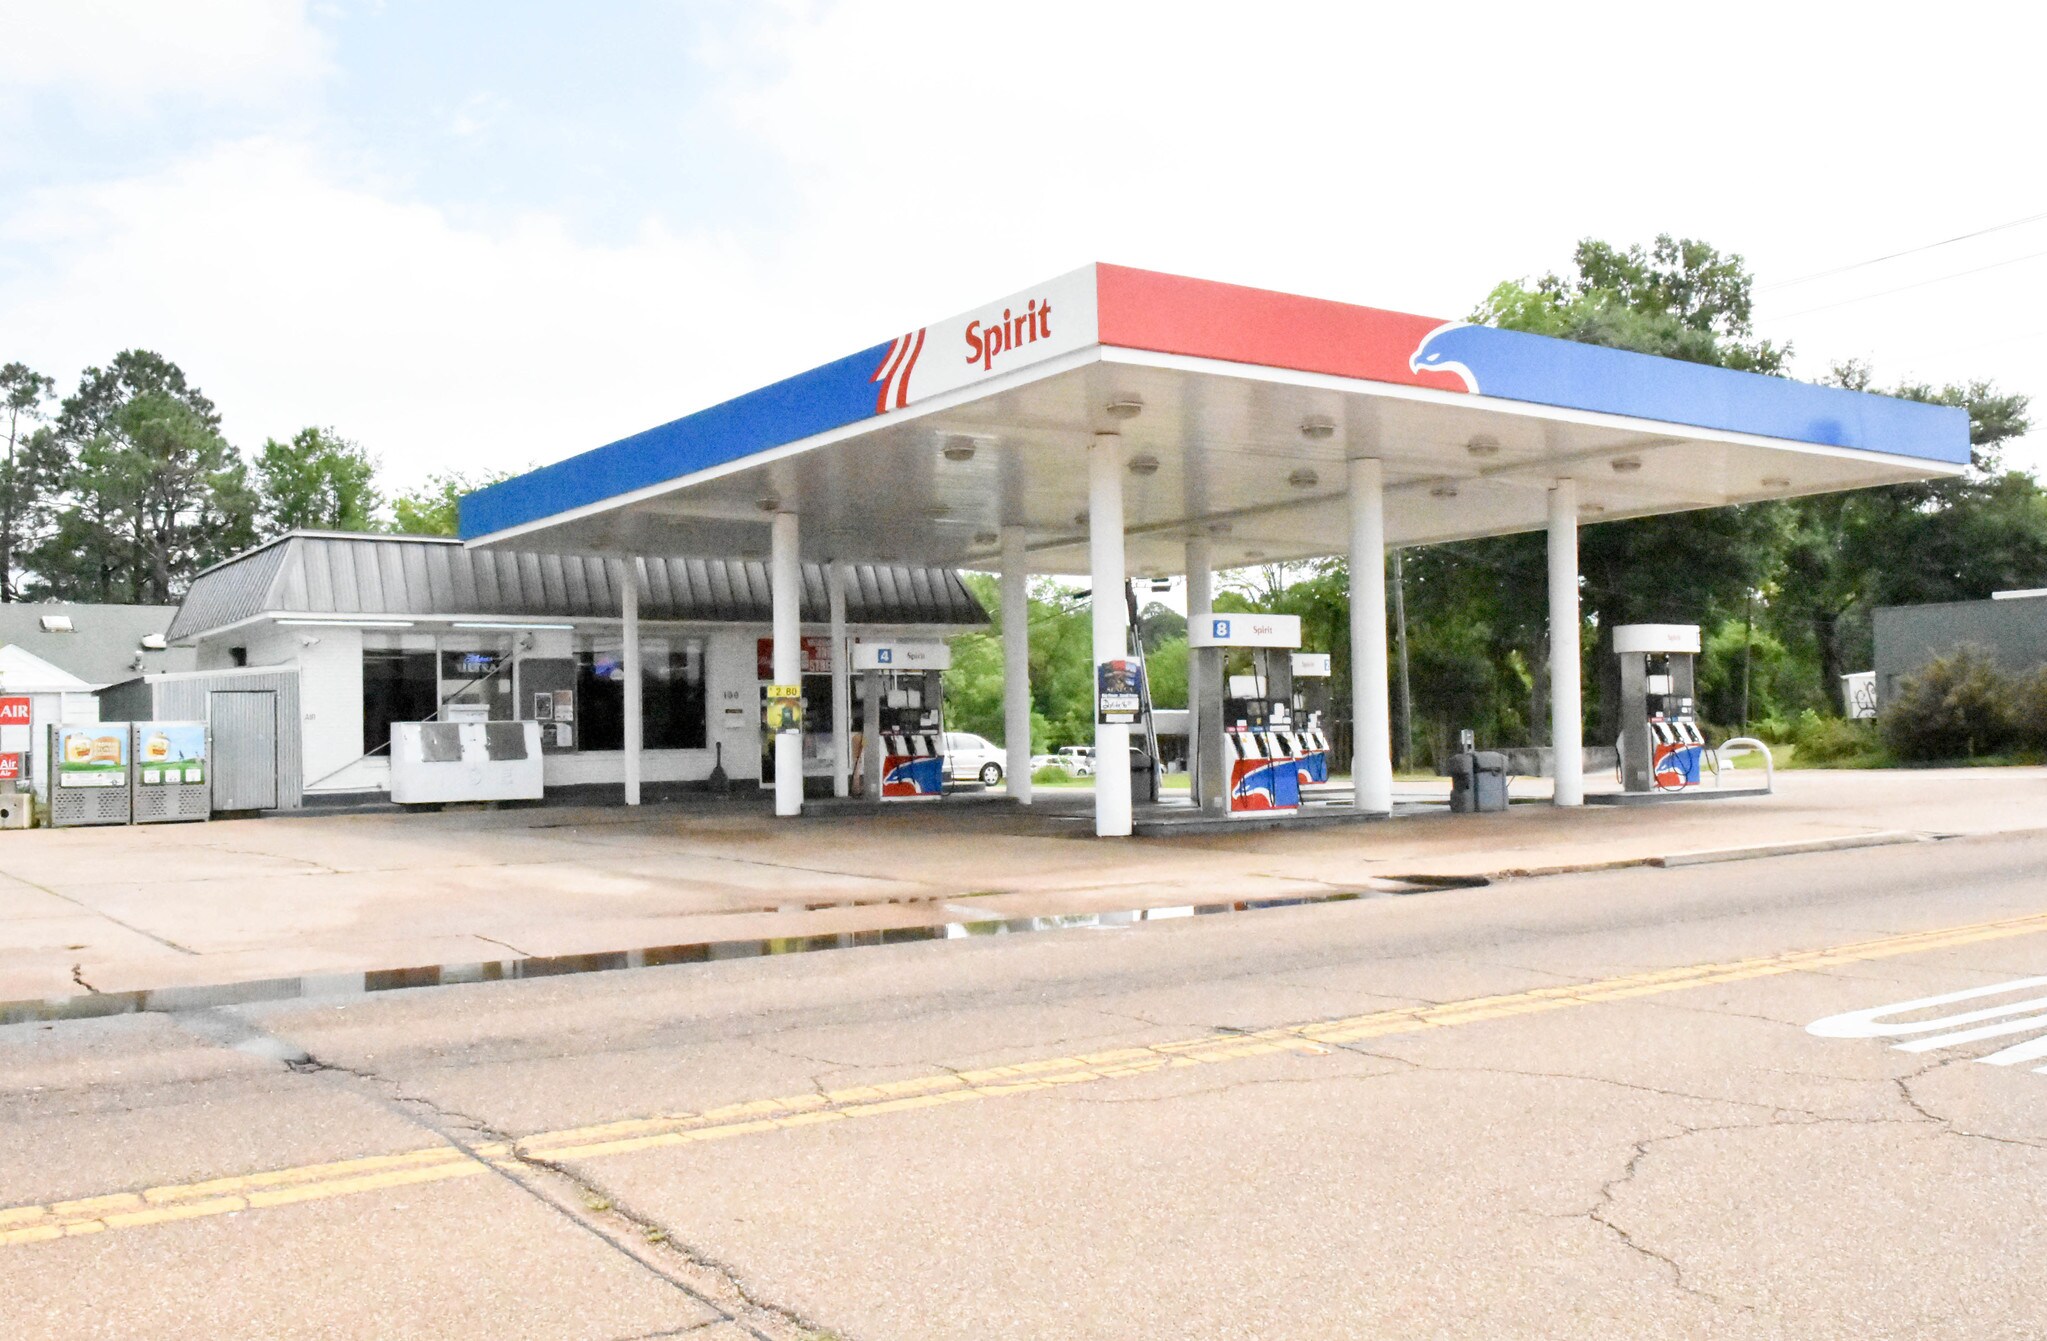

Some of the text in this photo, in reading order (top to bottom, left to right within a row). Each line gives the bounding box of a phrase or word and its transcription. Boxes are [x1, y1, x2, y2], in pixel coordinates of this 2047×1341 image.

[965, 298, 1052, 371] Spirit
[1216, 621, 1273, 636] 8 Spirit
[880, 651, 926, 661] 4 Spirit
[775, 687, 798, 696] 2 80
[0, 704, 29, 718] AIR
[0, 759, 16, 769] Air
